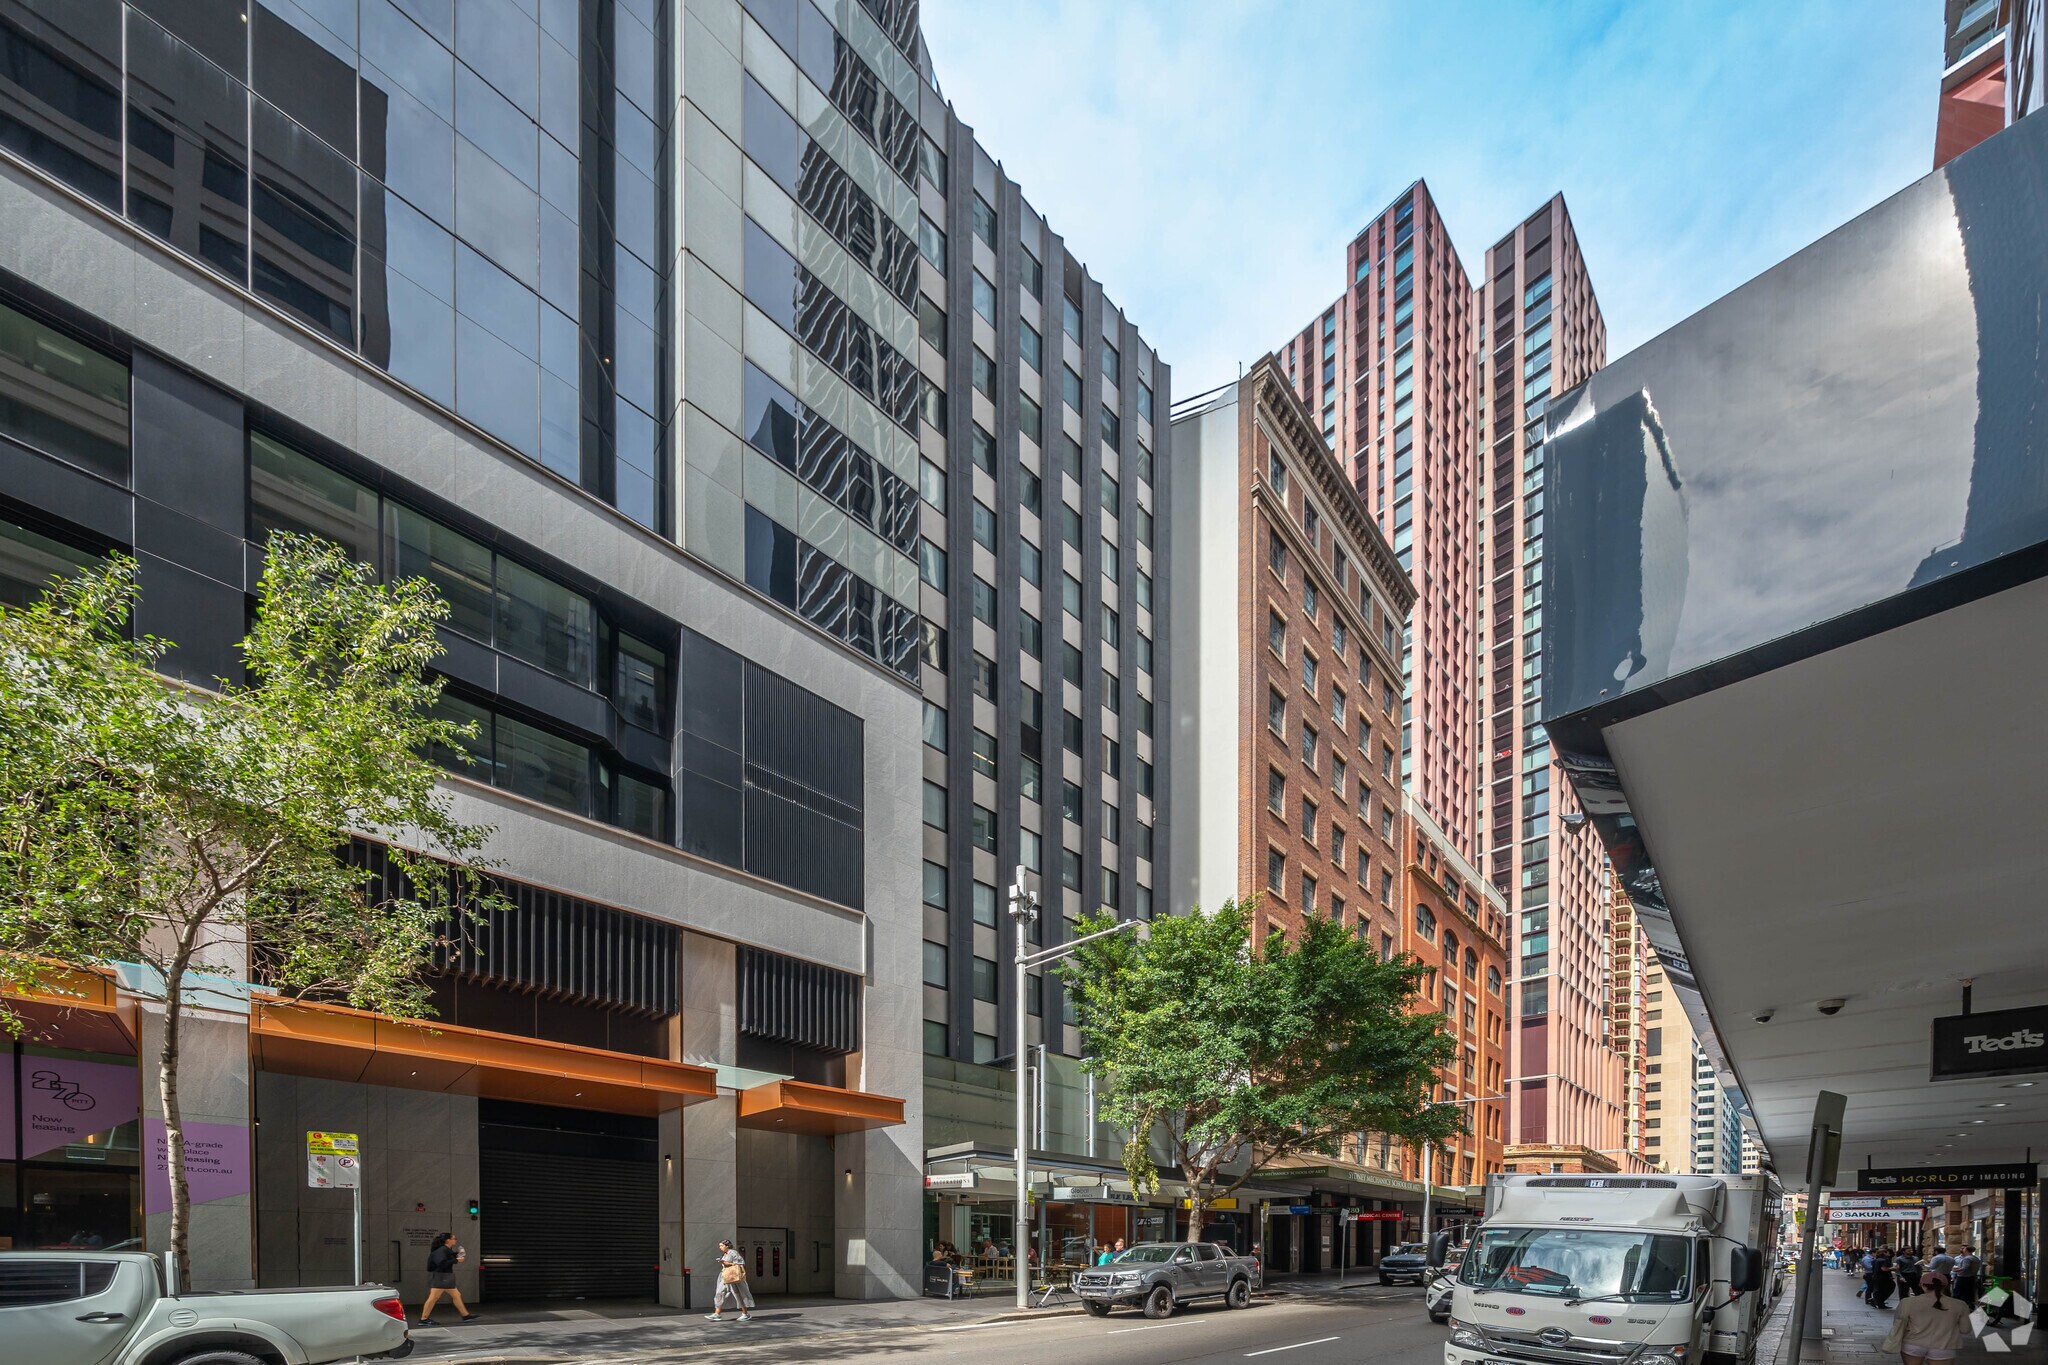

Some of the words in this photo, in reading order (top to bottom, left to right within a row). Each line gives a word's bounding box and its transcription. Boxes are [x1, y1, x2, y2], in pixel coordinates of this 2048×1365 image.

[1963, 1028, 2045, 1054] Ted's
[32, 1114, 62, 1123] Now
[32, 1123, 76, 1134] leasing
[183, 1140, 223, 1149] A-grade
[184, 1155, 221, 1165] leasing
[157, 1164, 233, 1175] 27itt.com.au
[1348, 1171, 1366, 1181] SYDNEY
[1366, 1175, 1391, 1186] MECHANICS
[1391, 1179, 1407, 1189] SCHOOL
[1868, 1175, 1897, 1184] Ted's
[1901, 1174, 1958, 1183] WORLD
[1980, 1172, 2025, 1180] IMAGING
[1474, 1302, 1500, 1310] HINO
